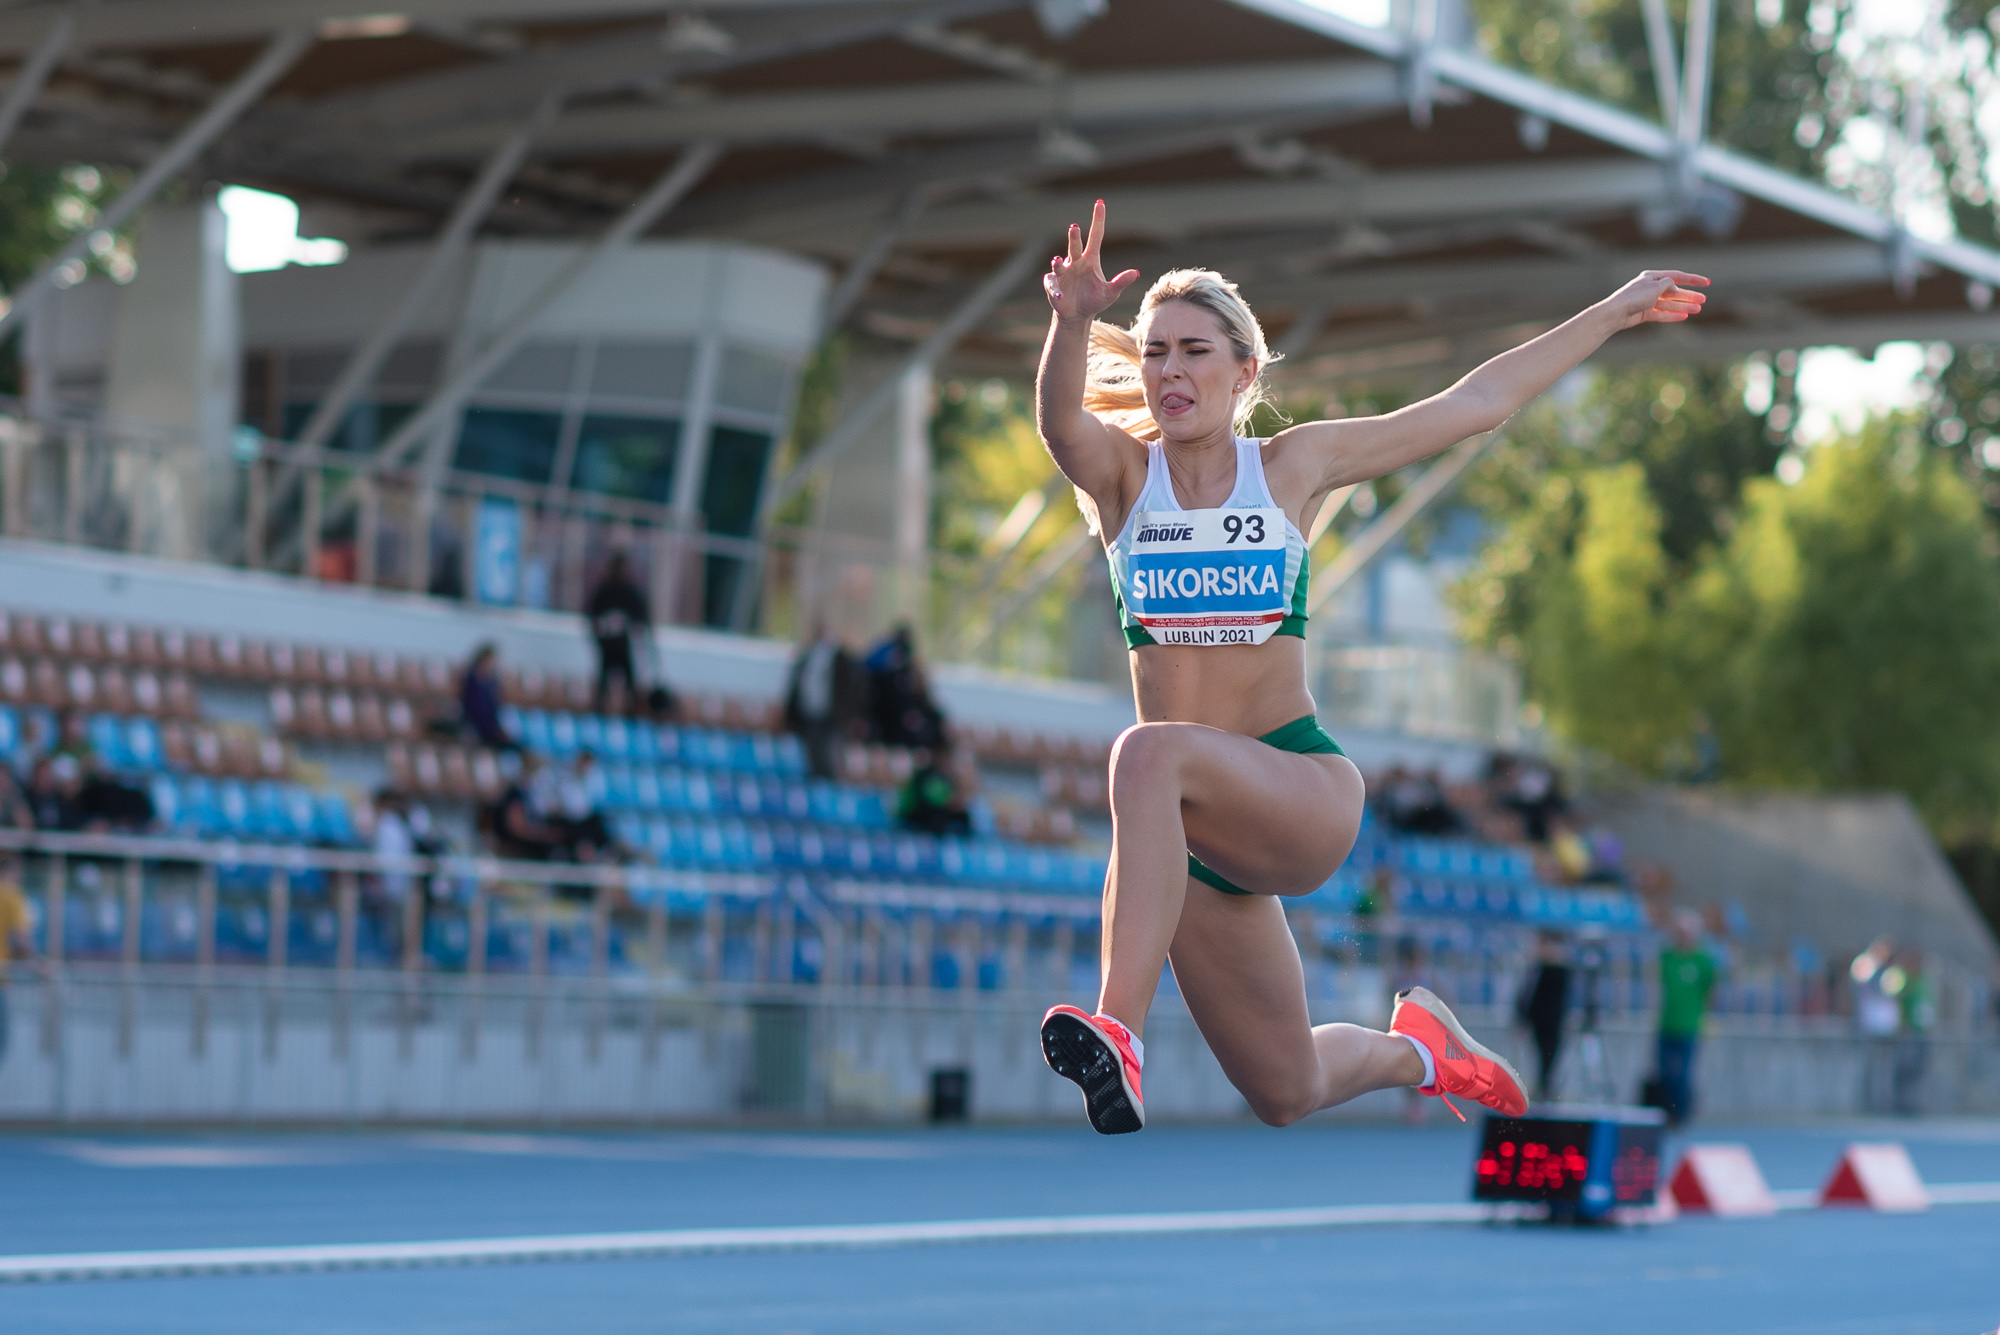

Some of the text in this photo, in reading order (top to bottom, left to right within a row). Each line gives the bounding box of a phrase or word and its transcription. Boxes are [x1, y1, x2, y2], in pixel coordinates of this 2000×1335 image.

[1137, 527, 1193, 543] 4MOVE
[1223, 514, 1265, 544] 93
[1132, 565, 1279, 599] SIKORSKA
[1165, 629, 1254, 643] LUBLIN 2021
